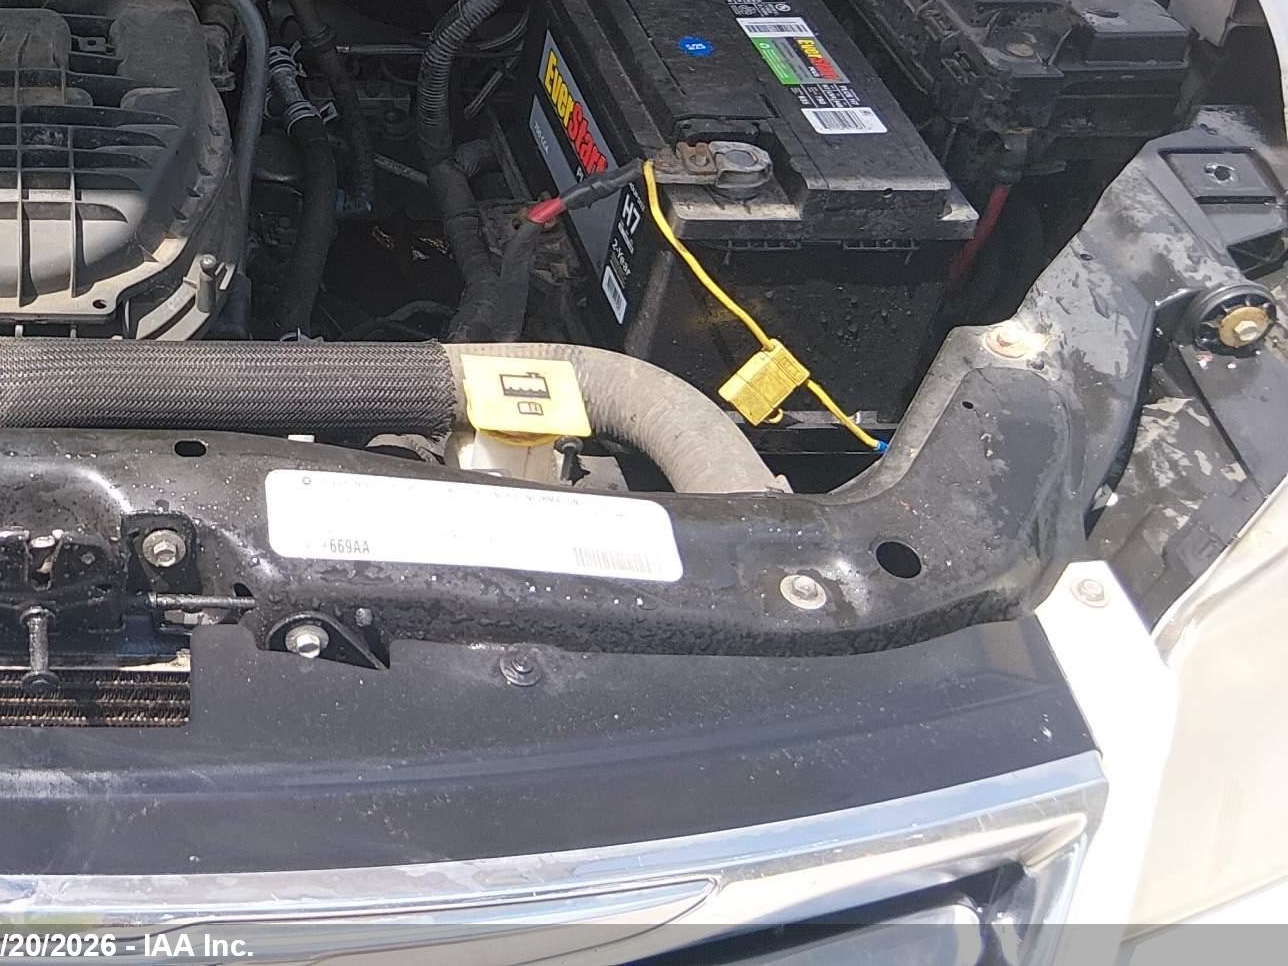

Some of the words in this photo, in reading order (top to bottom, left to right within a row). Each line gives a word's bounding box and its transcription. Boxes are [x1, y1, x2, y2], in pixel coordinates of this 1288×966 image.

[544, 48, 608, 177] EverStart
[622, 194, 641, 235] H7
[612, 238, 631, 276] 2-Year
[323, 538, 370, 554] 669AA
